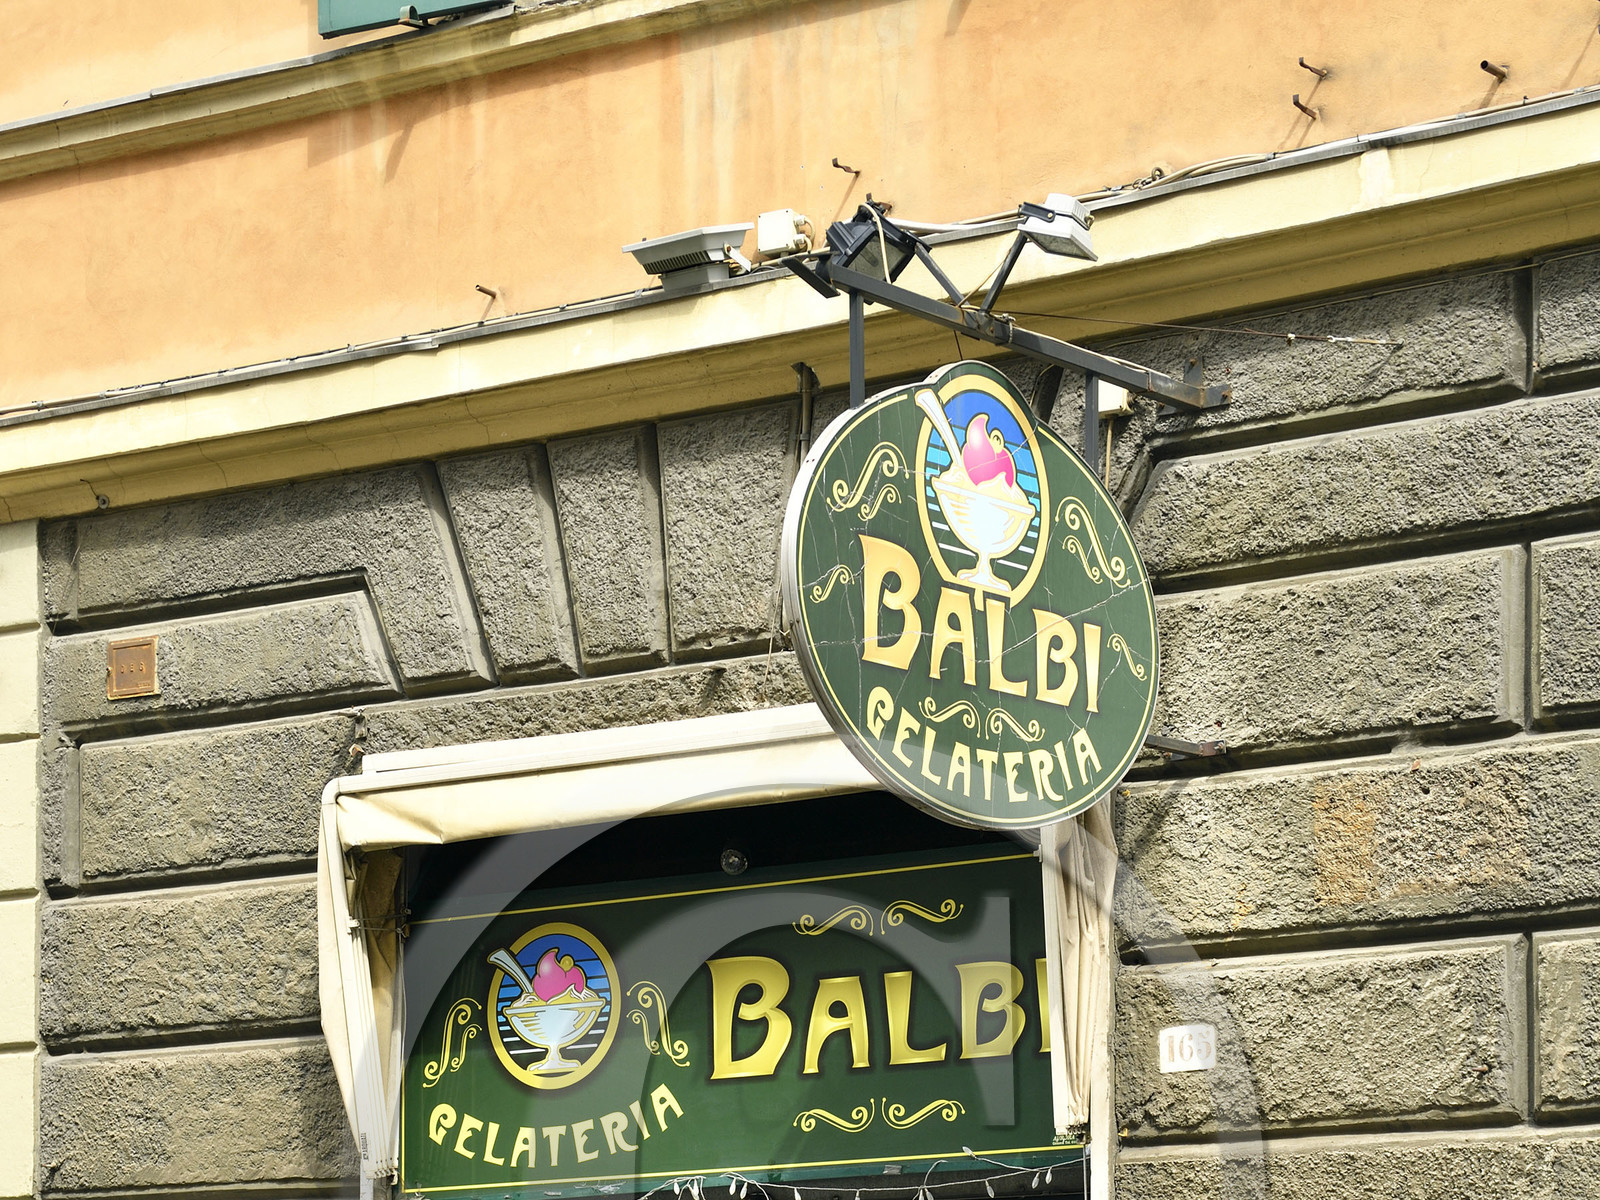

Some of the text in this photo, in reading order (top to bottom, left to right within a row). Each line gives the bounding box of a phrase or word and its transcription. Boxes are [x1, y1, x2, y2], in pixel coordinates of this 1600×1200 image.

[858, 534, 1101, 713] BALBI
[866, 686, 1102, 802] GELATERIA
[1165, 1031, 1212, 1063] 165
[427, 1082, 685, 1168] GELATERIA
